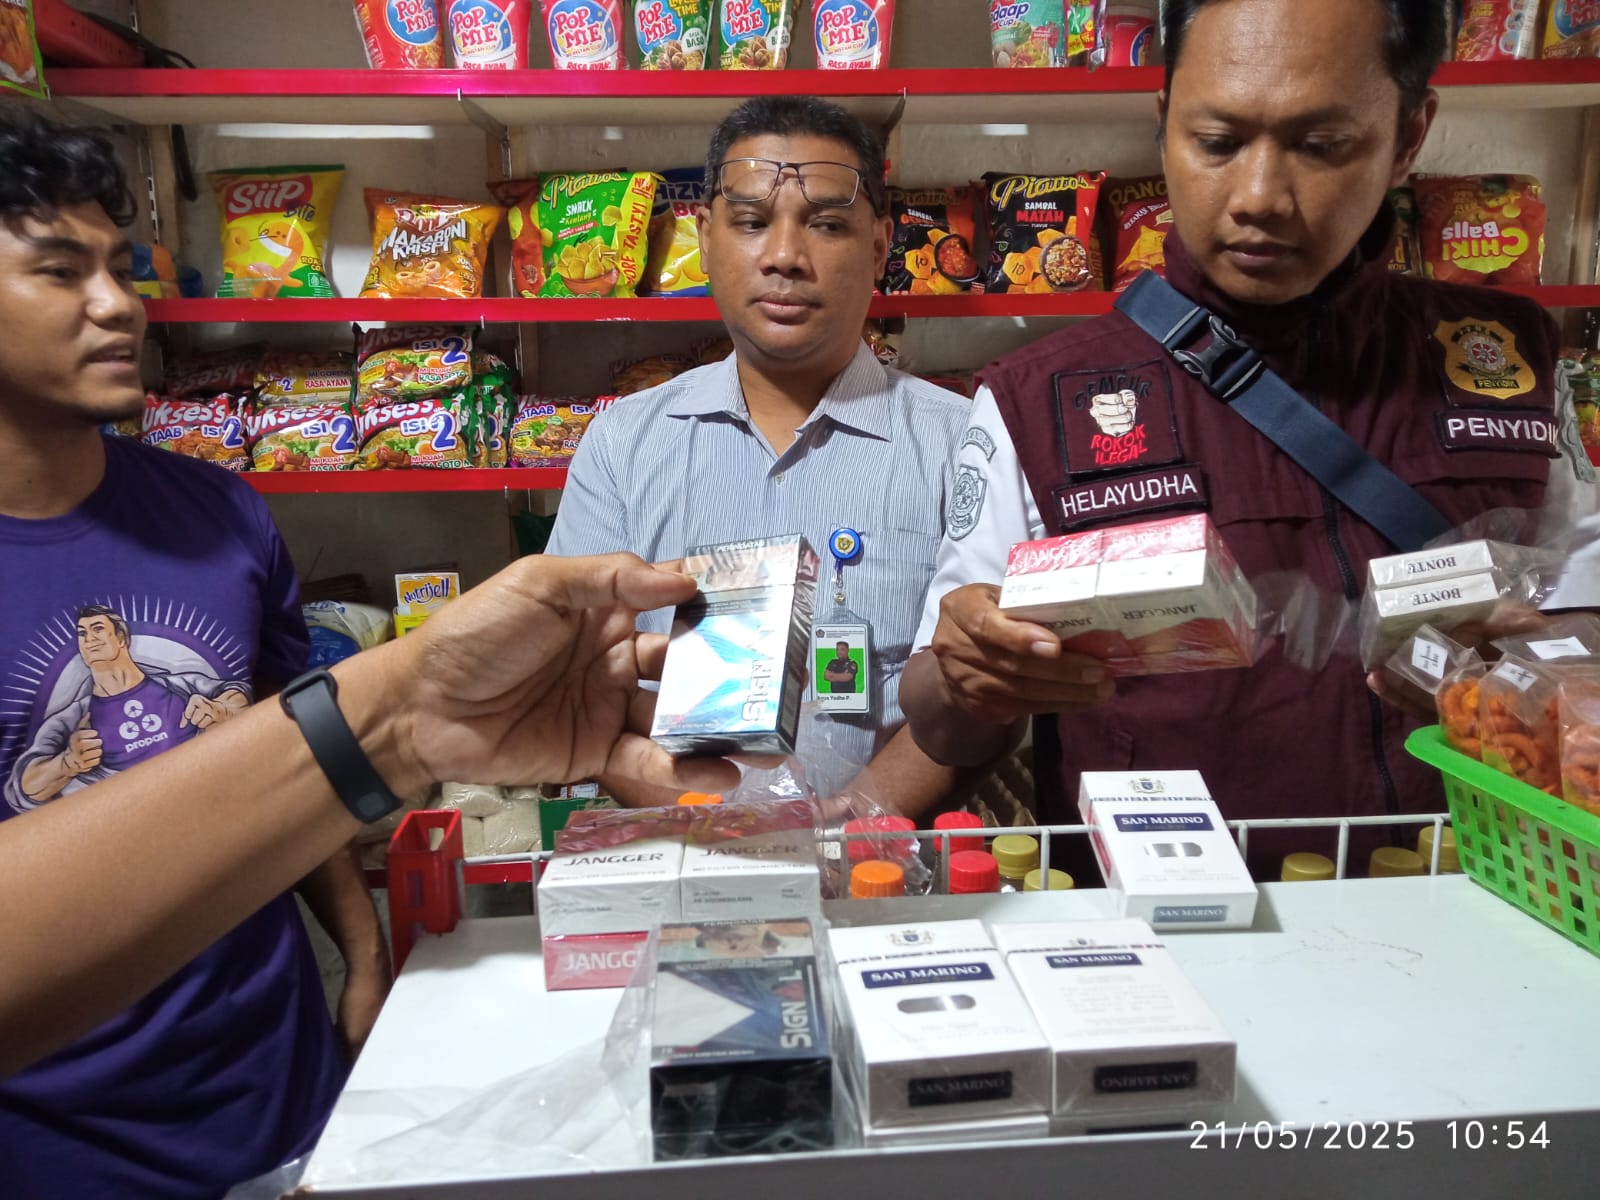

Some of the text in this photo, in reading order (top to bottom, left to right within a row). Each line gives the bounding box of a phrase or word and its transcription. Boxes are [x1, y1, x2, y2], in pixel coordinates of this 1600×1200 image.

[396, 0, 423, 20] POP
[638, 2, 662, 29] POP
[675, 3, 698, 17] TIME
[726, 0, 750, 22] POP
[764, 2, 783, 15] TIM
[822, 7, 854, 32] POP
[405, 9, 436, 33] MIE
[453, 8, 484, 34] POP
[555, 8, 589, 35] POP
[645, 14, 676, 43] MIE
[731, 10, 763, 35] MIE
[461, 24, 497, 48] MIE
[565, 22, 602, 48] MIE
[686, 35, 705, 48] BASO
[771, 35, 789, 45] BSO
[829, 22, 864, 46] MIE
[991, 175, 1096, 210] Piattos
[1016, 210, 1064, 222] MATAH
[1025, 202, 1057, 210] SAMBAL
[377, 218, 466, 254] MAKARONI
[1442, 221, 1499, 240] Balls
[393, 237, 450, 260] KRISPI
[415, 337, 467, 363] ISI 2
[305, 378, 347, 388] RASA AYAM
[419, 374, 441, 382] RASA
[1073, 375, 1152, 411] GEMPUR
[223, 416, 243, 446] 2
[304, 417, 356, 450] ISI 2
[403, 414, 456, 448] ISI 2
[1090, 424, 1147, 453] ROKOK
[1095, 439, 1149, 465] ILEGAL
[1061, 473, 1198, 518] HELAYUDHA
[1408, 556, 1458, 574] BONTE
[404, 578, 450, 604] Nutrijell
[1412, 588, 1463, 606] BONTE
[1122, 603, 1200, 620] JANGGER
[125, 731, 168, 753] propan
[1121, 816, 1204, 825] SAN MARINO
[564, 852, 664, 866] JANGGER
[699, 844, 799, 857] JANGGER
[1158, 907, 1225, 917] SAN MARINO
[1052, 953, 1133, 964] SAN MARINO
[871, 965, 983, 983] SAN MARINO
[916, 1077, 1006, 1095] SAN MARINO
